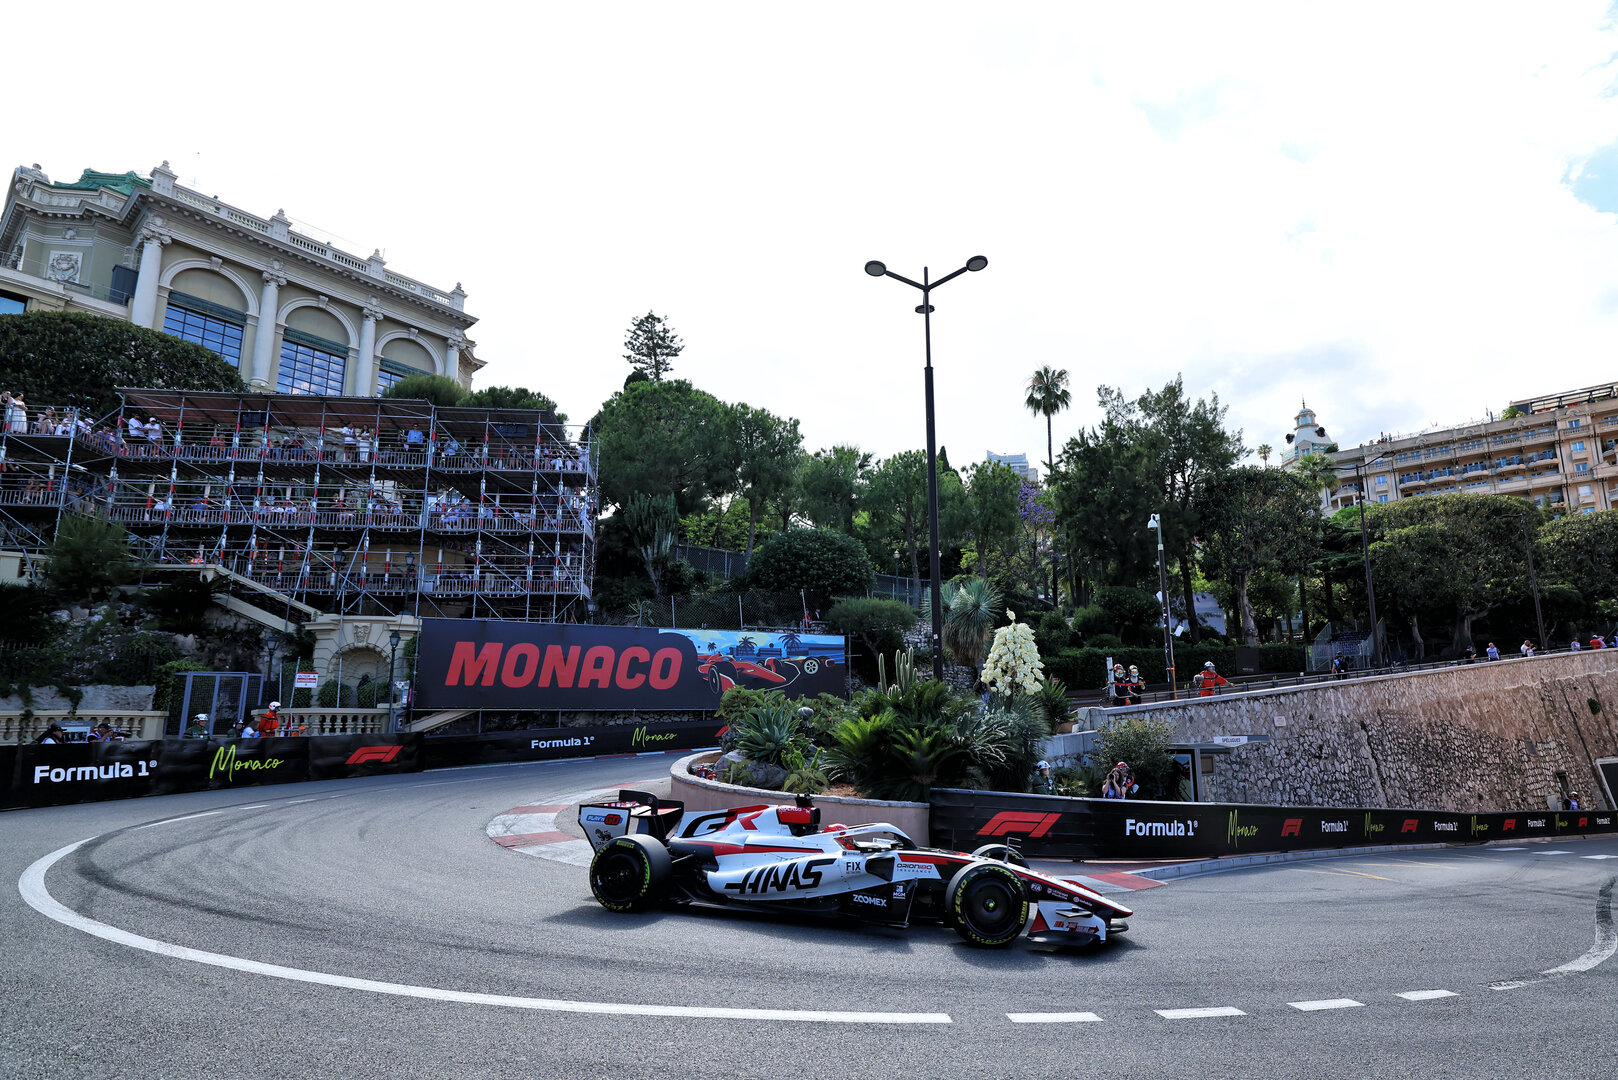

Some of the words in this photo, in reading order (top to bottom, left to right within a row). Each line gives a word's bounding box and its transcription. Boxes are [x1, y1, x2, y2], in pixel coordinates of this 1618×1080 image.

[445, 641, 683, 690] MONACO
[531, 737, 581, 749] Formula
[631, 726, 678, 748] Monaco
[209, 744, 284, 782] Monaco
[34, 762, 133, 784] Formula
[1126, 819, 1185, 836] Formula
[1227, 809, 1258, 848] Monaco
[1321, 820, 1343, 833] Formula
[1434, 821, 1453, 831] Formula
[846, 861, 861, 871] FIX
[725, 858, 836, 895] HAAS
[853, 894, 887, 907] ZOOMEX
